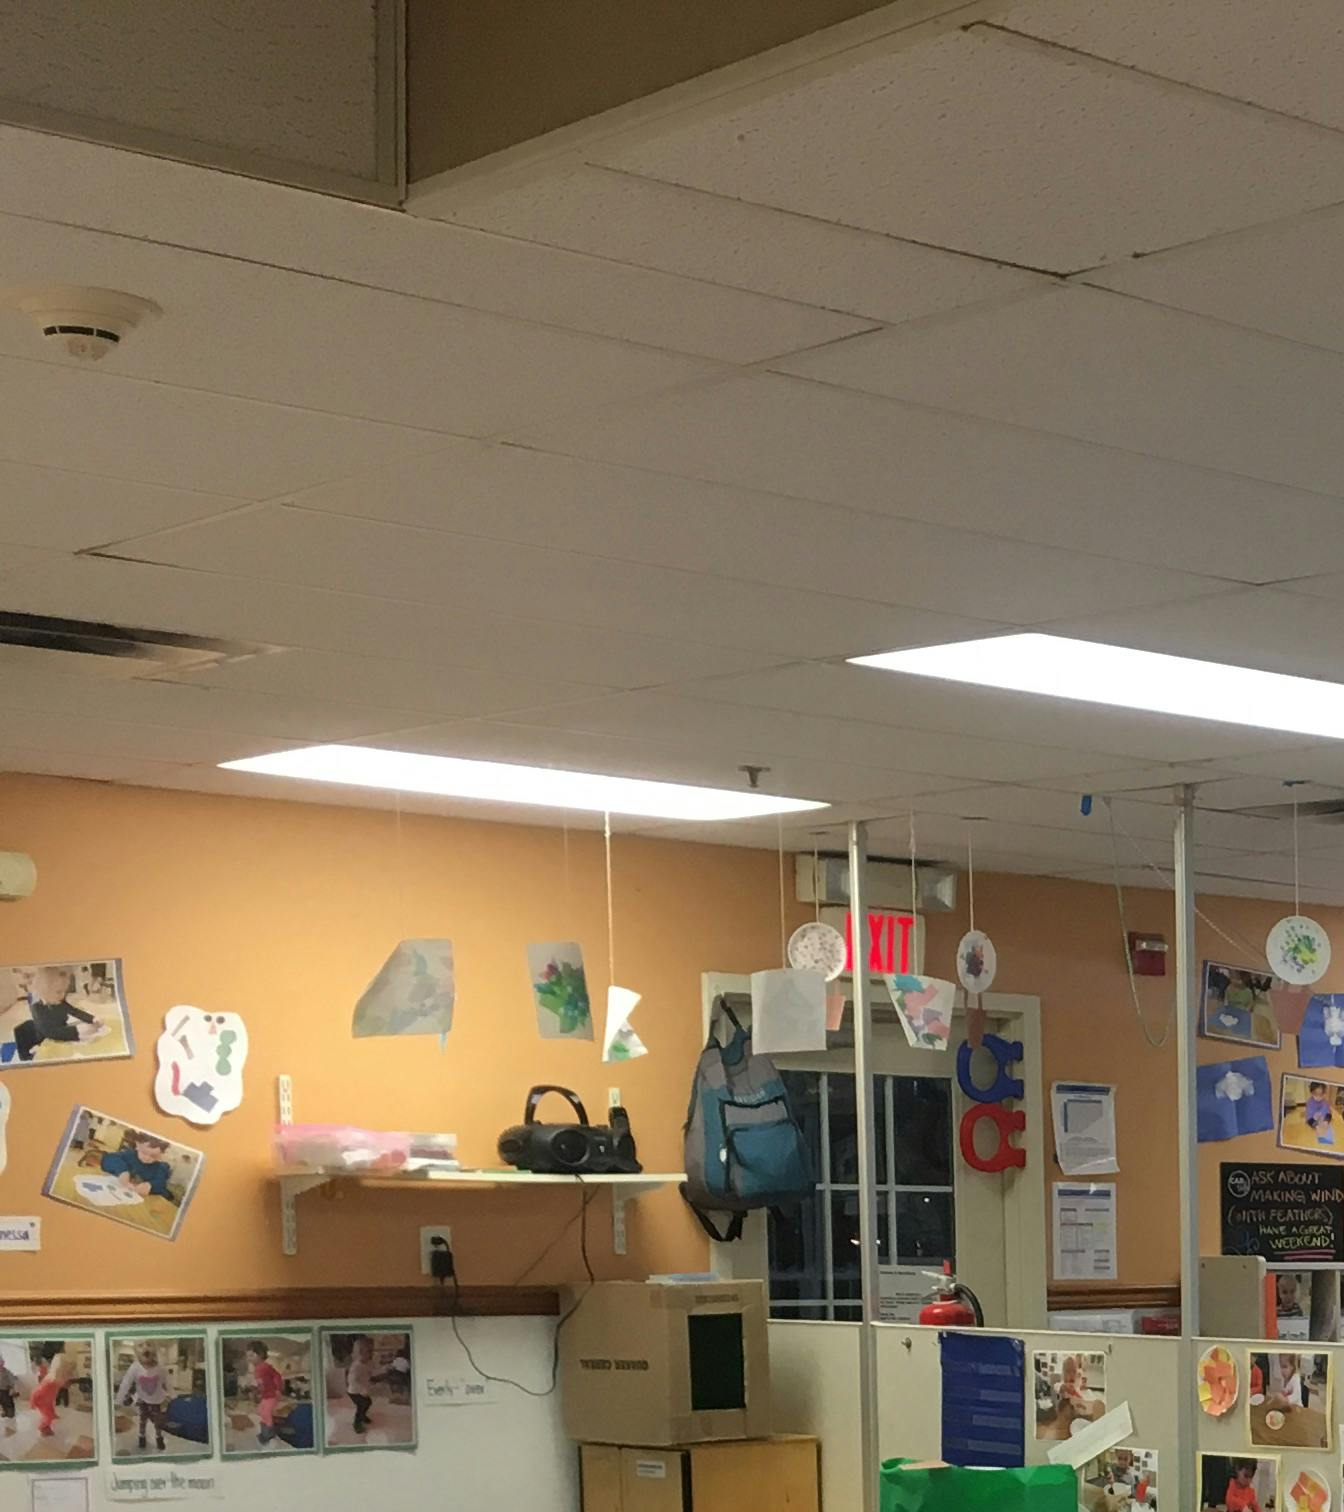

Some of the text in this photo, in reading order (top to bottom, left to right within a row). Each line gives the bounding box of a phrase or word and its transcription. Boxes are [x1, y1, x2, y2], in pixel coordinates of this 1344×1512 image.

[1251, 1170, 1320, 1185] ASK ABOUT
[1250, 1188, 1344, 1204] MAKING WIND
[1269, 1232, 1334, 1250] WEEKEND!
